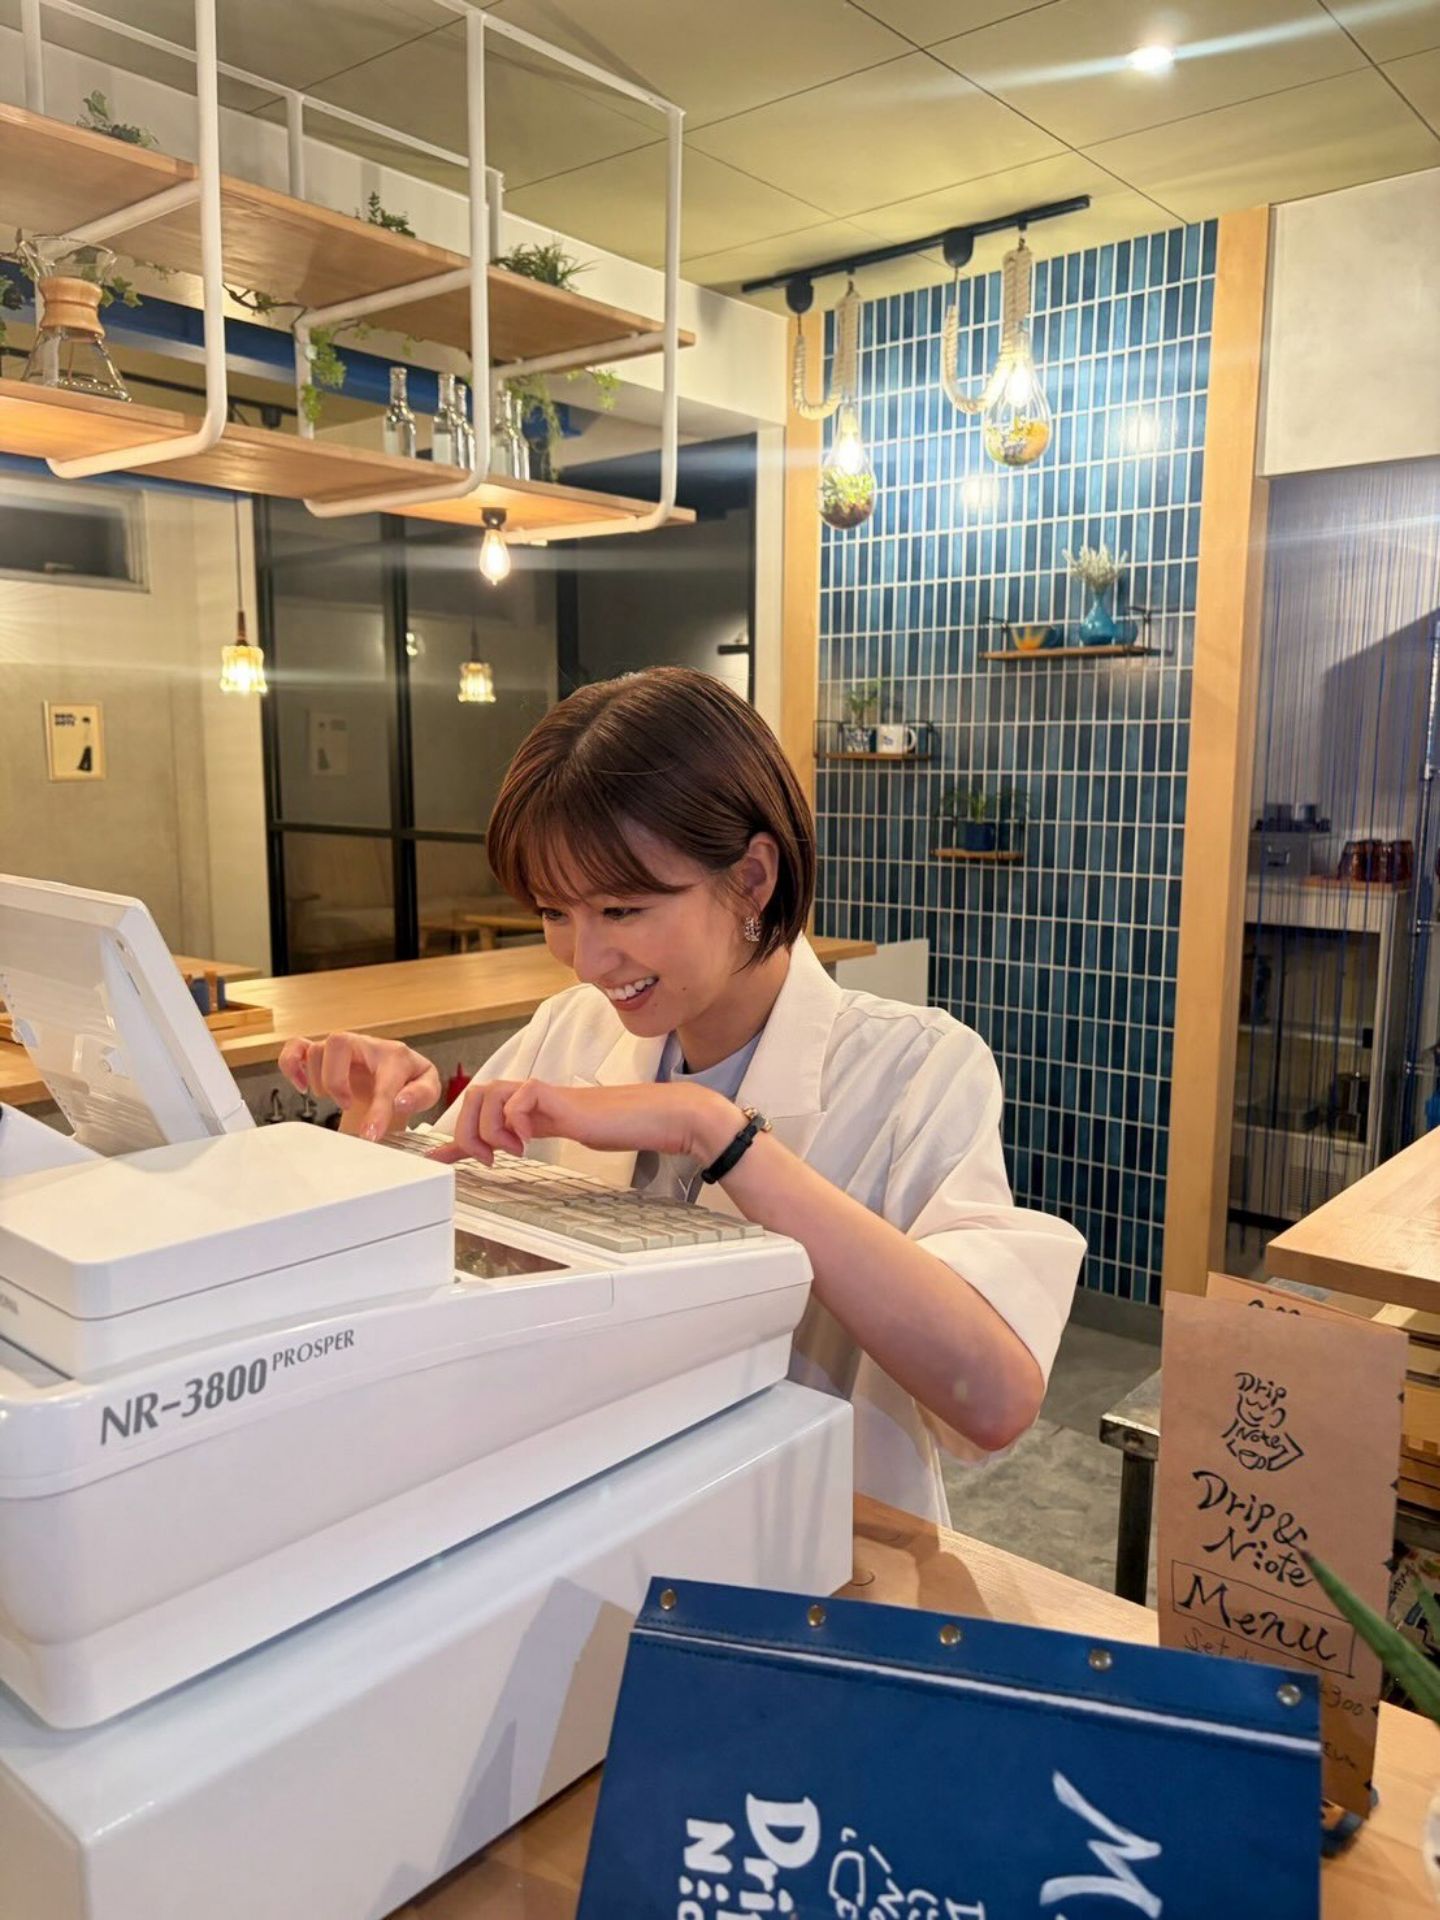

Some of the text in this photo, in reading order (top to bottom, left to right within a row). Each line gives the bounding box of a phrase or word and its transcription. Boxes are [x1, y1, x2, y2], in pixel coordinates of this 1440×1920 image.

[100, 1328, 355, 1446] NR-3800 PROSPER
[1234, 1371, 1288, 1408] Drip
[1235, 1427, 1283, 1449] Note
[1177, 1573, 1337, 1661] Menu
[1039, 1769, 1163, 1920] M
